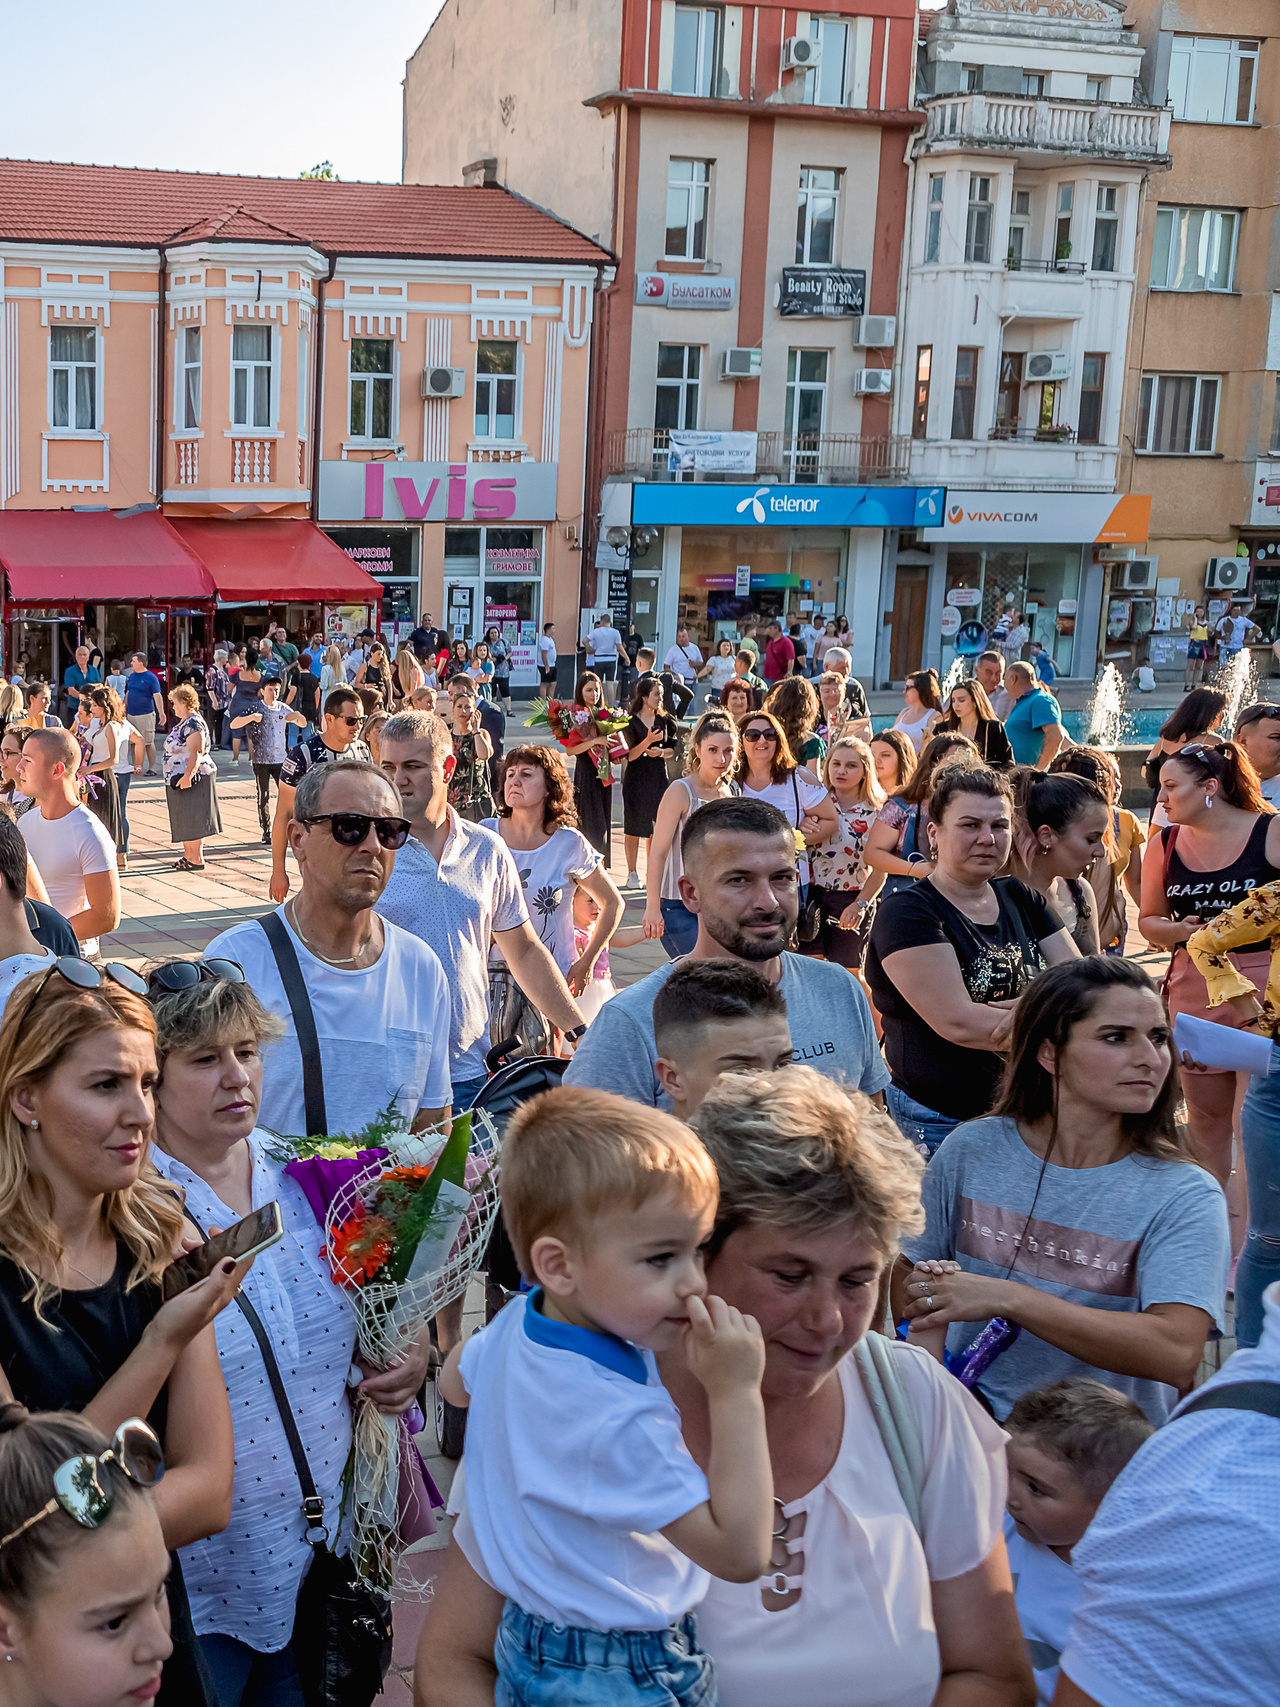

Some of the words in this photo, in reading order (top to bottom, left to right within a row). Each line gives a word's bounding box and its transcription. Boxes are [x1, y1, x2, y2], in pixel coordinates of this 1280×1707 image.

[671, 282, 732, 299] Булсатком
[788, 278, 822, 295] Beauty
[826, 278, 852, 293] Room
[364, 463, 517, 519] Ivis
[770, 495, 820, 513] telenor
[967, 511, 1038, 522] VIVACOM
[344, 546, 391, 559] МАРКОВИ
[485, 548, 540, 559] КОЗМЕТИКА
[355, 560, 394, 572] ФЮМИ
[492, 562, 533, 571] ГРИМОВЕ
[485, 609, 517, 617] ЗАТВОРЕНО
[1166, 883, 1214, 898] CRAZY
[1219, 878, 1257, 893] OLD
[792, 1042, 836, 1062] CLUB
